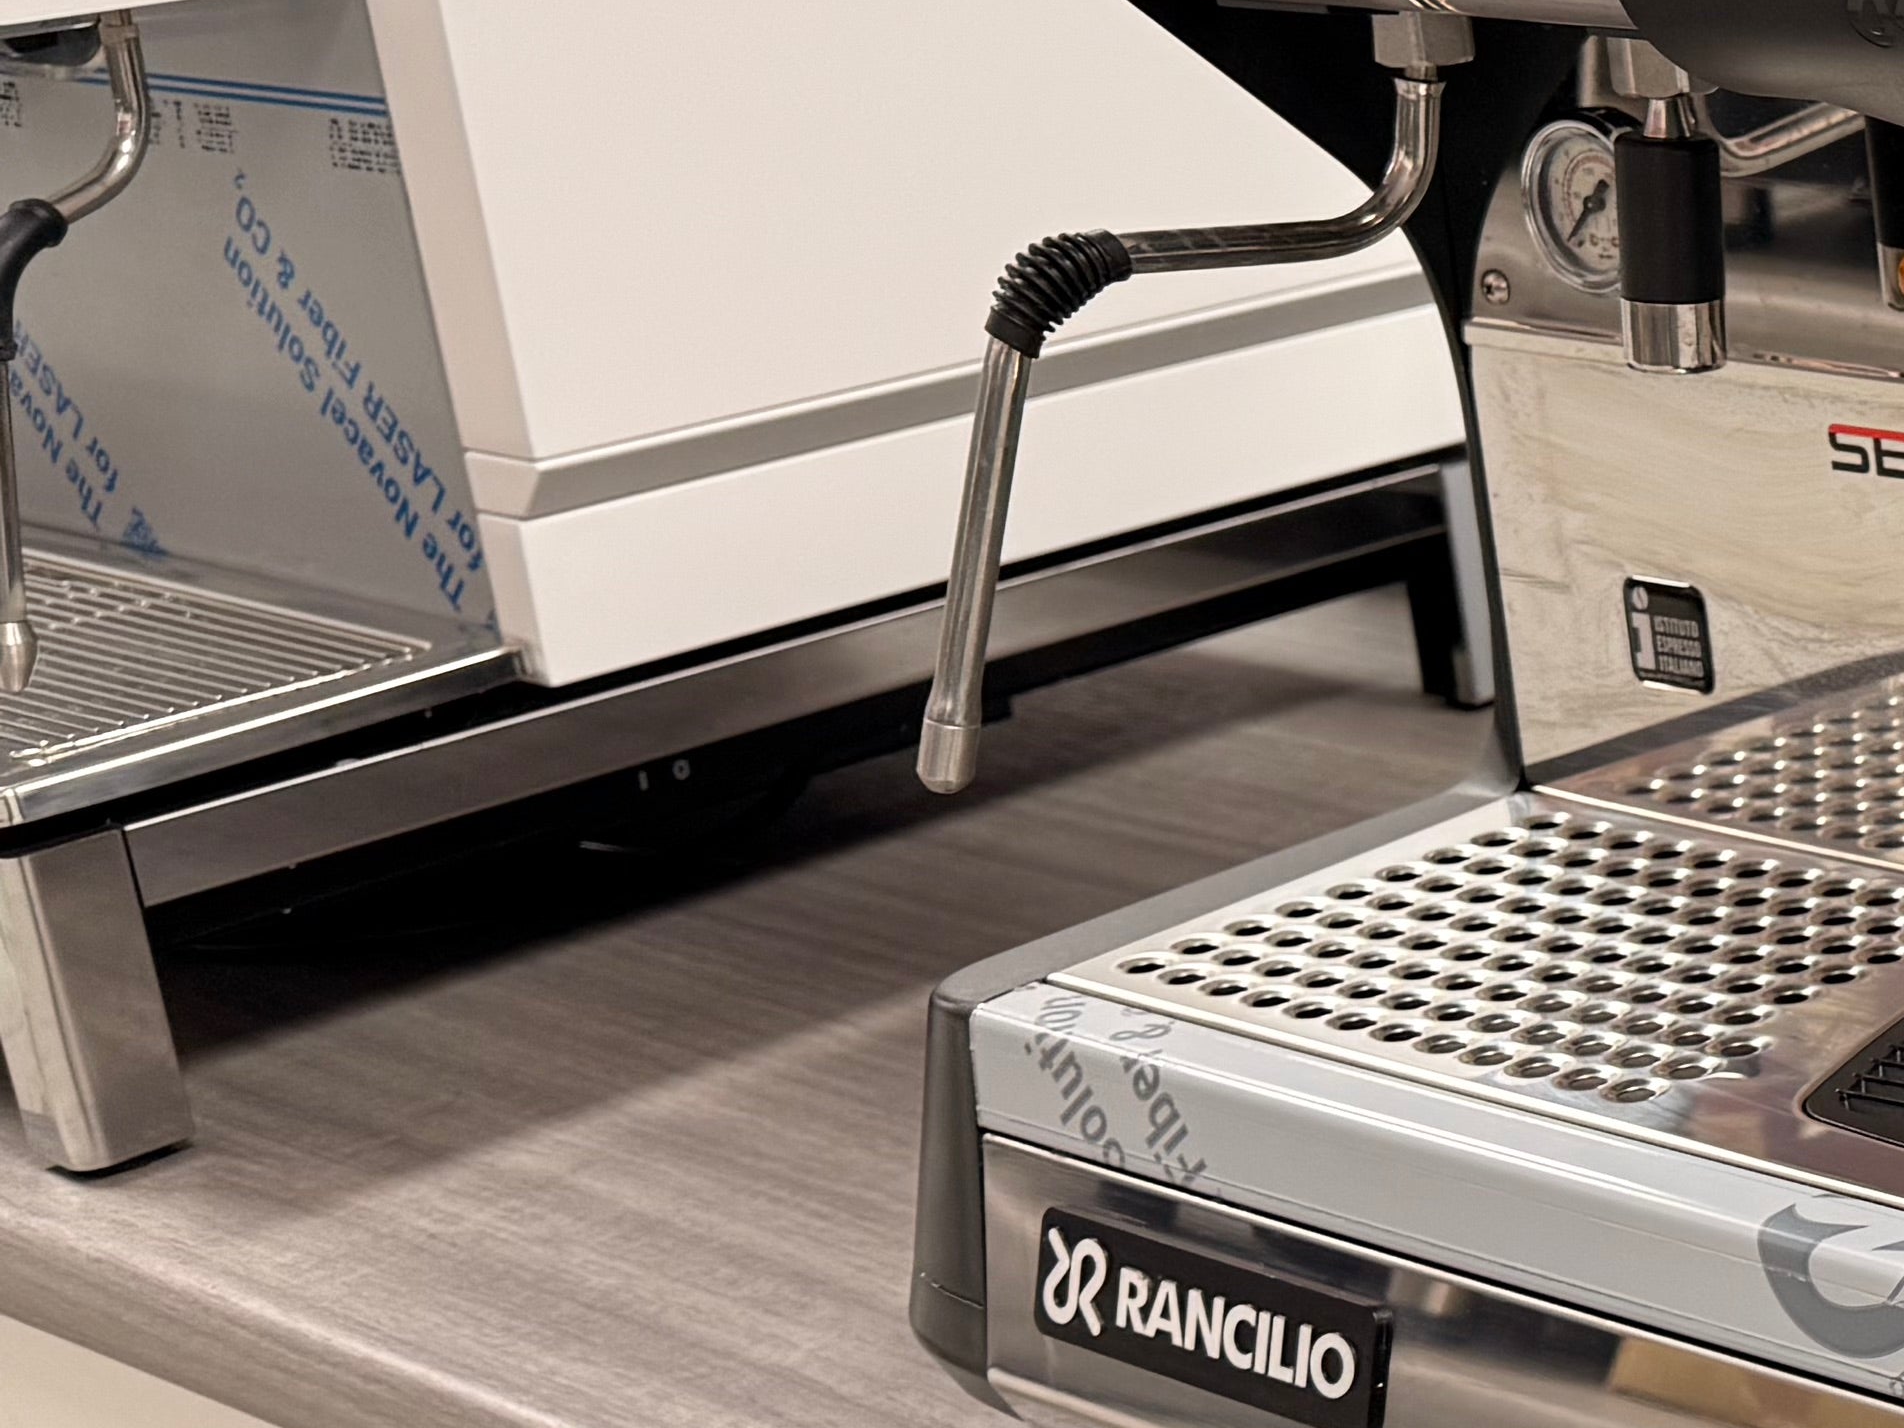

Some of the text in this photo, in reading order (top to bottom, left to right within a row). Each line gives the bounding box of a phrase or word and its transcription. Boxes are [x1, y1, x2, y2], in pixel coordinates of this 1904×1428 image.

[297, 289, 363, 390] Fiber
[85, 436, 119, 493] for
[224, 236, 466, 613] The Novacel Solution
[362, 381, 446, 514] LASER
[65, 458, 103, 531] The
[446, 511, 484, 572] for
[1116, 1266, 1357, 1400] RANCILIO
